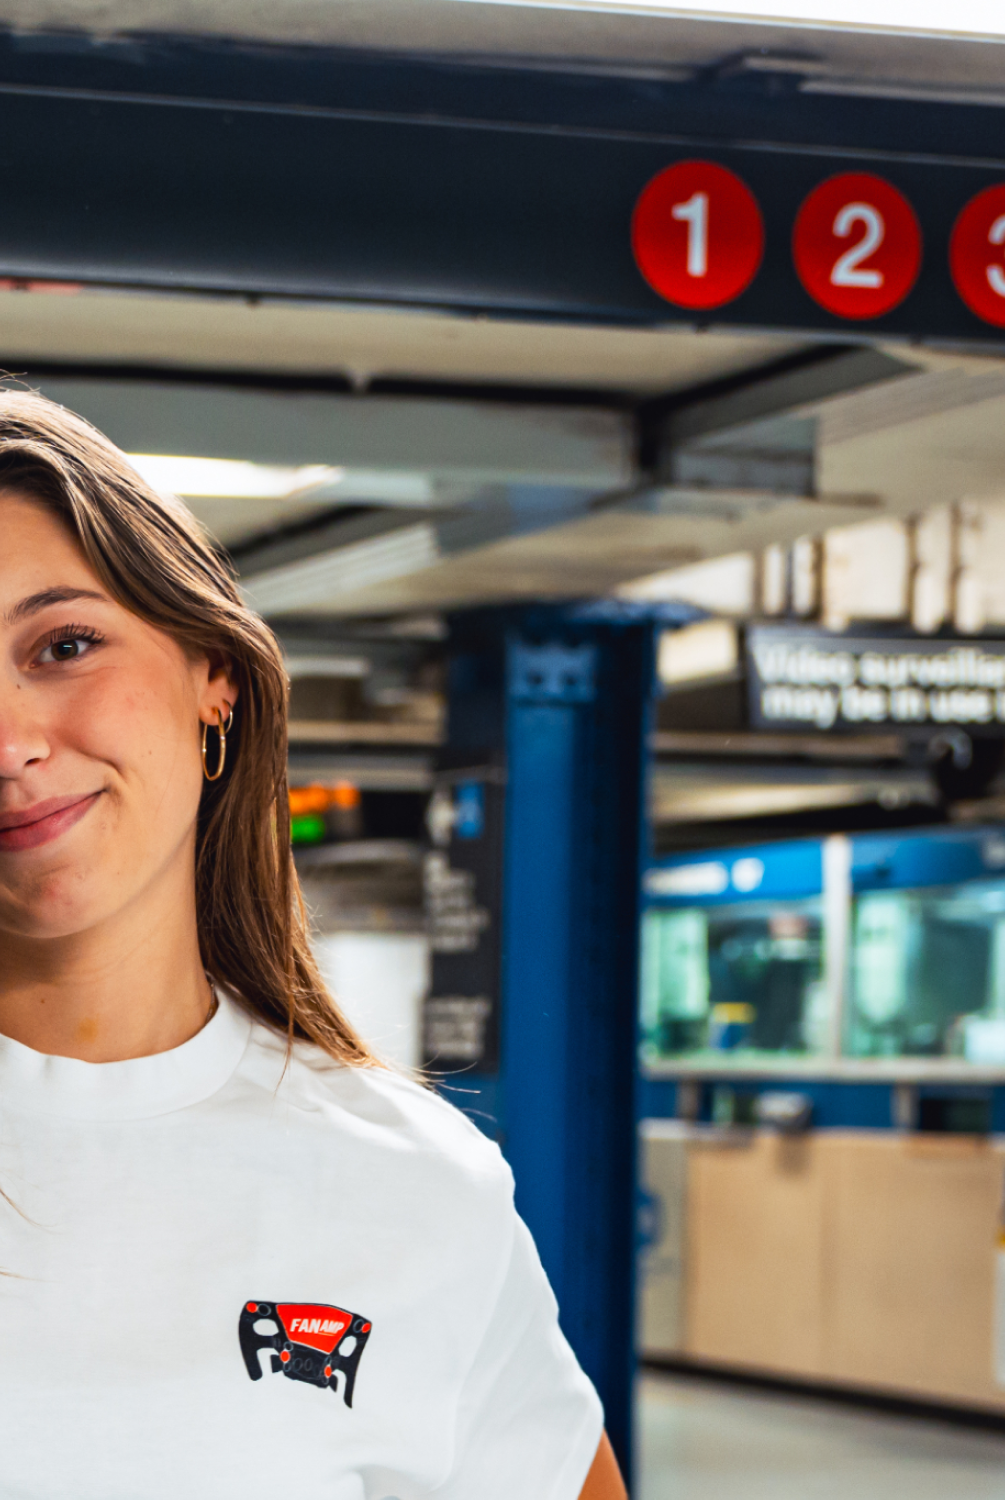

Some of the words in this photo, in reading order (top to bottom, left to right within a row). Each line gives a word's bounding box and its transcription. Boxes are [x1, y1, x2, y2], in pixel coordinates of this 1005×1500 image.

[672, 192, 709, 278] 1
[831, 202, 885, 288] 2
[290, 1318, 345, 1335] FANAMP
